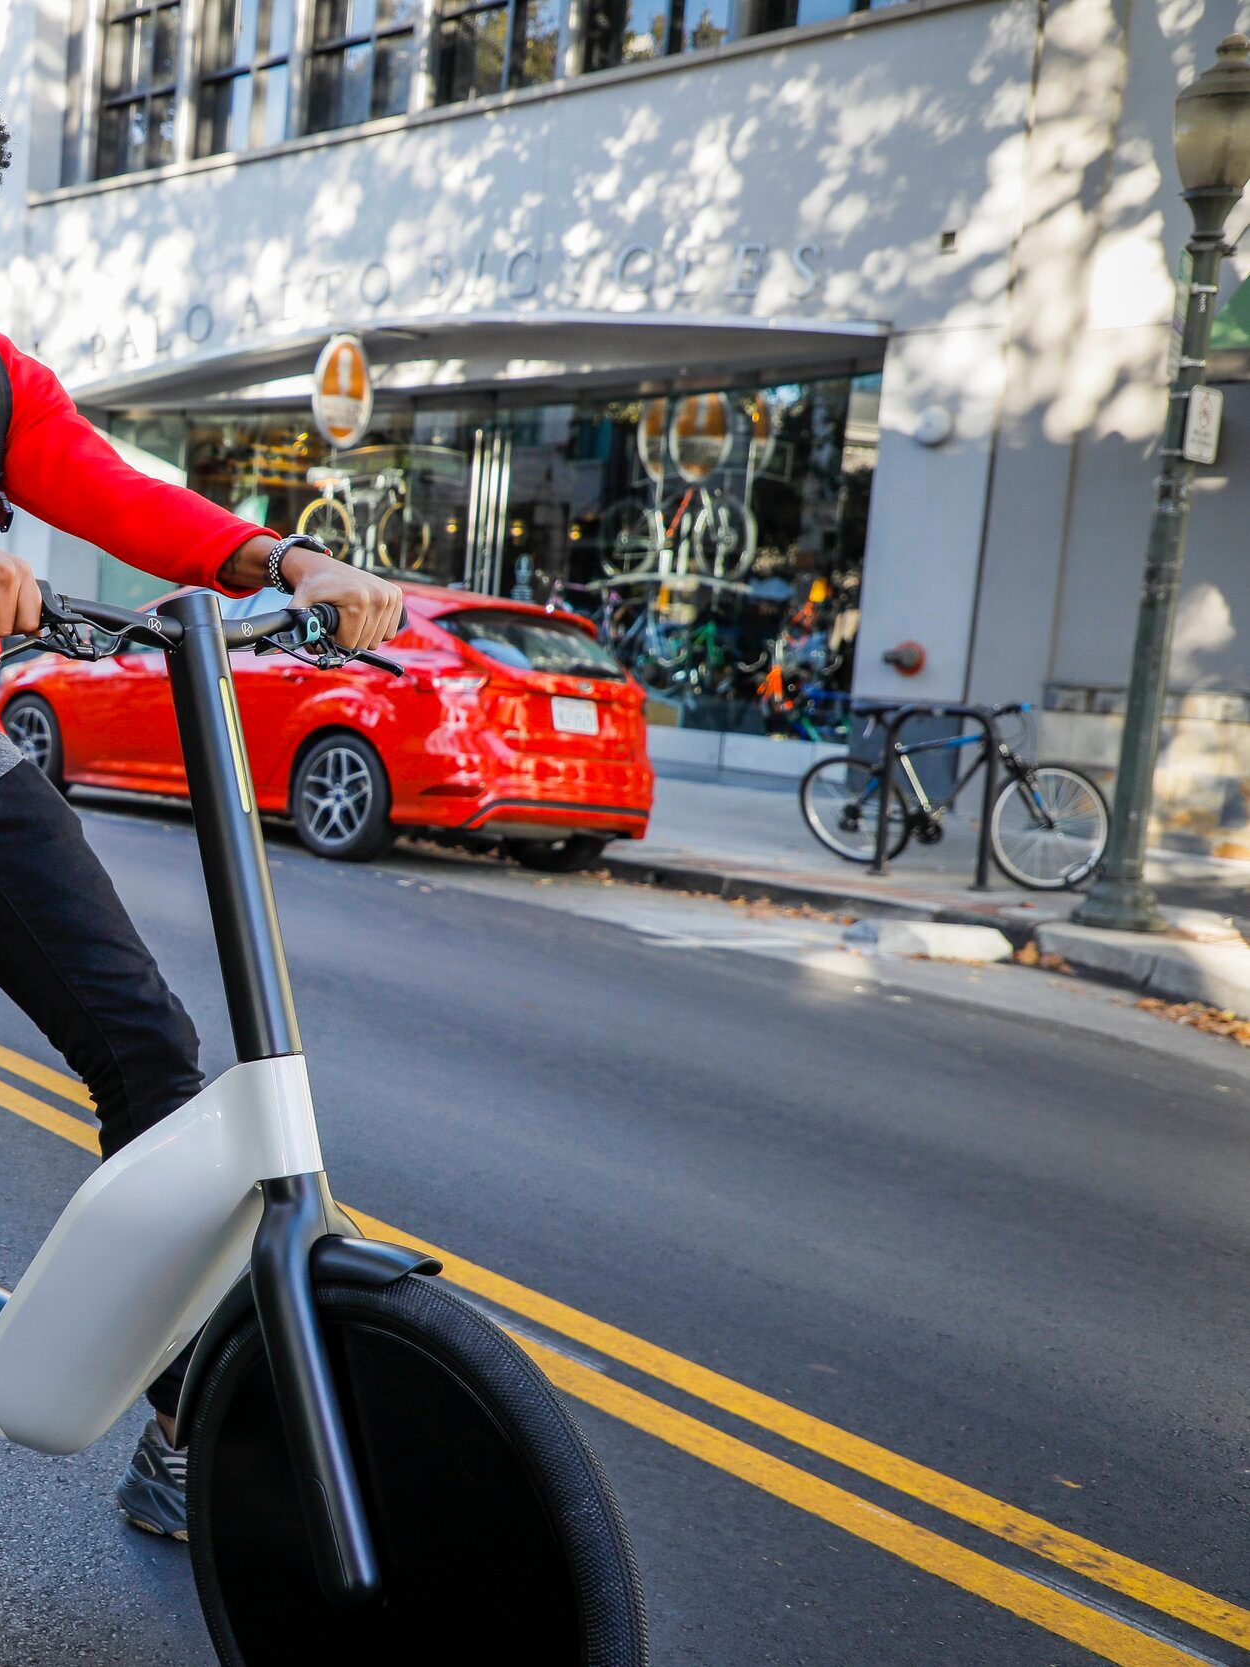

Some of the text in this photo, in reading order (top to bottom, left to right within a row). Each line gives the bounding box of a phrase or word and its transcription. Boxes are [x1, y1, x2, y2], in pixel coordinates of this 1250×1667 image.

[91, 241, 821, 369] PALO ALTO BICYCLES
